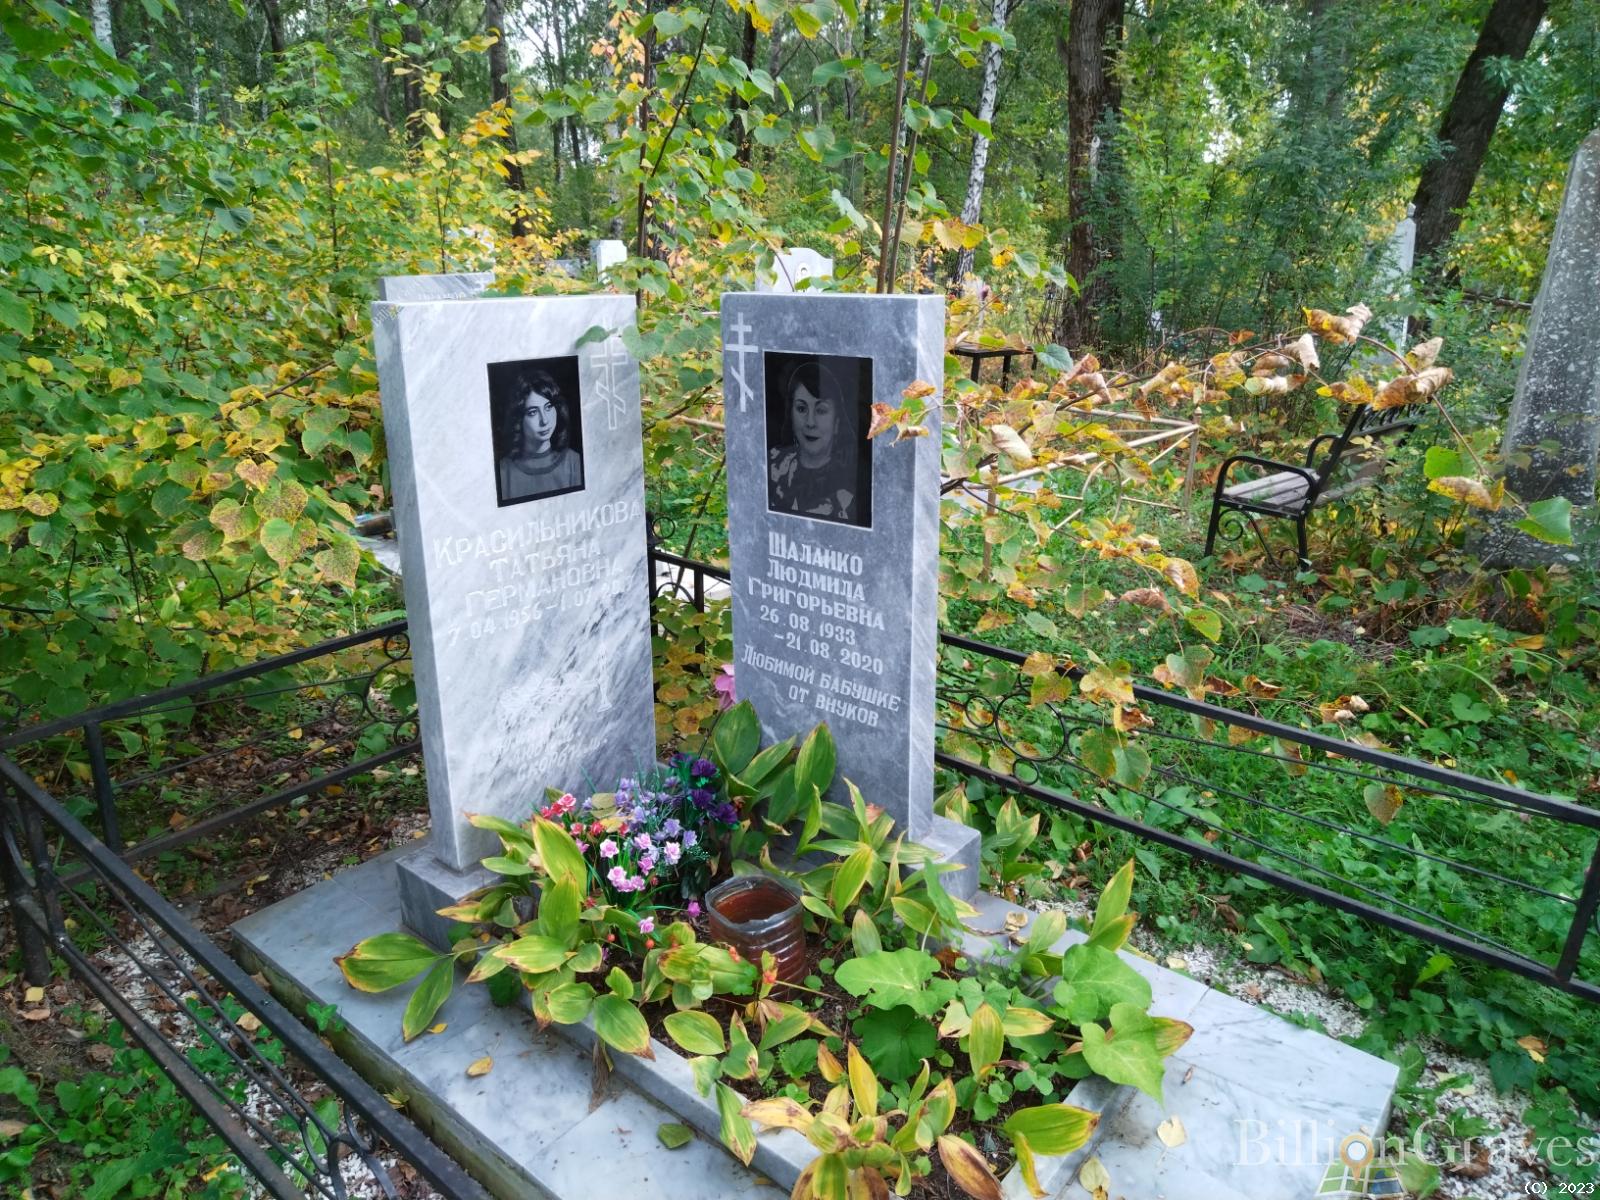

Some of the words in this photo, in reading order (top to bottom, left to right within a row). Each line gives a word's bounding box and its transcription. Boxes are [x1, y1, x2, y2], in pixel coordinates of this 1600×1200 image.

[433, 501, 641, 569] КРАСИЛЬНИКОВА
[489, 539, 601, 582] ТАТЬЯНА
[466, 557, 624, 617] ГЕРМАНОВНА
[748, 576, 885, 630] ГРИГОРЬЕВНА
[767, 558, 866, 601] ЛЮДМИЛА
[741, 644, 815, 684] ЛЮБИМОЙ
[819, 673, 901, 712] БАБУШКЕ
[788, 685, 809, 703] ОТ
[815, 693, 879, 726] ВНУКОВ
